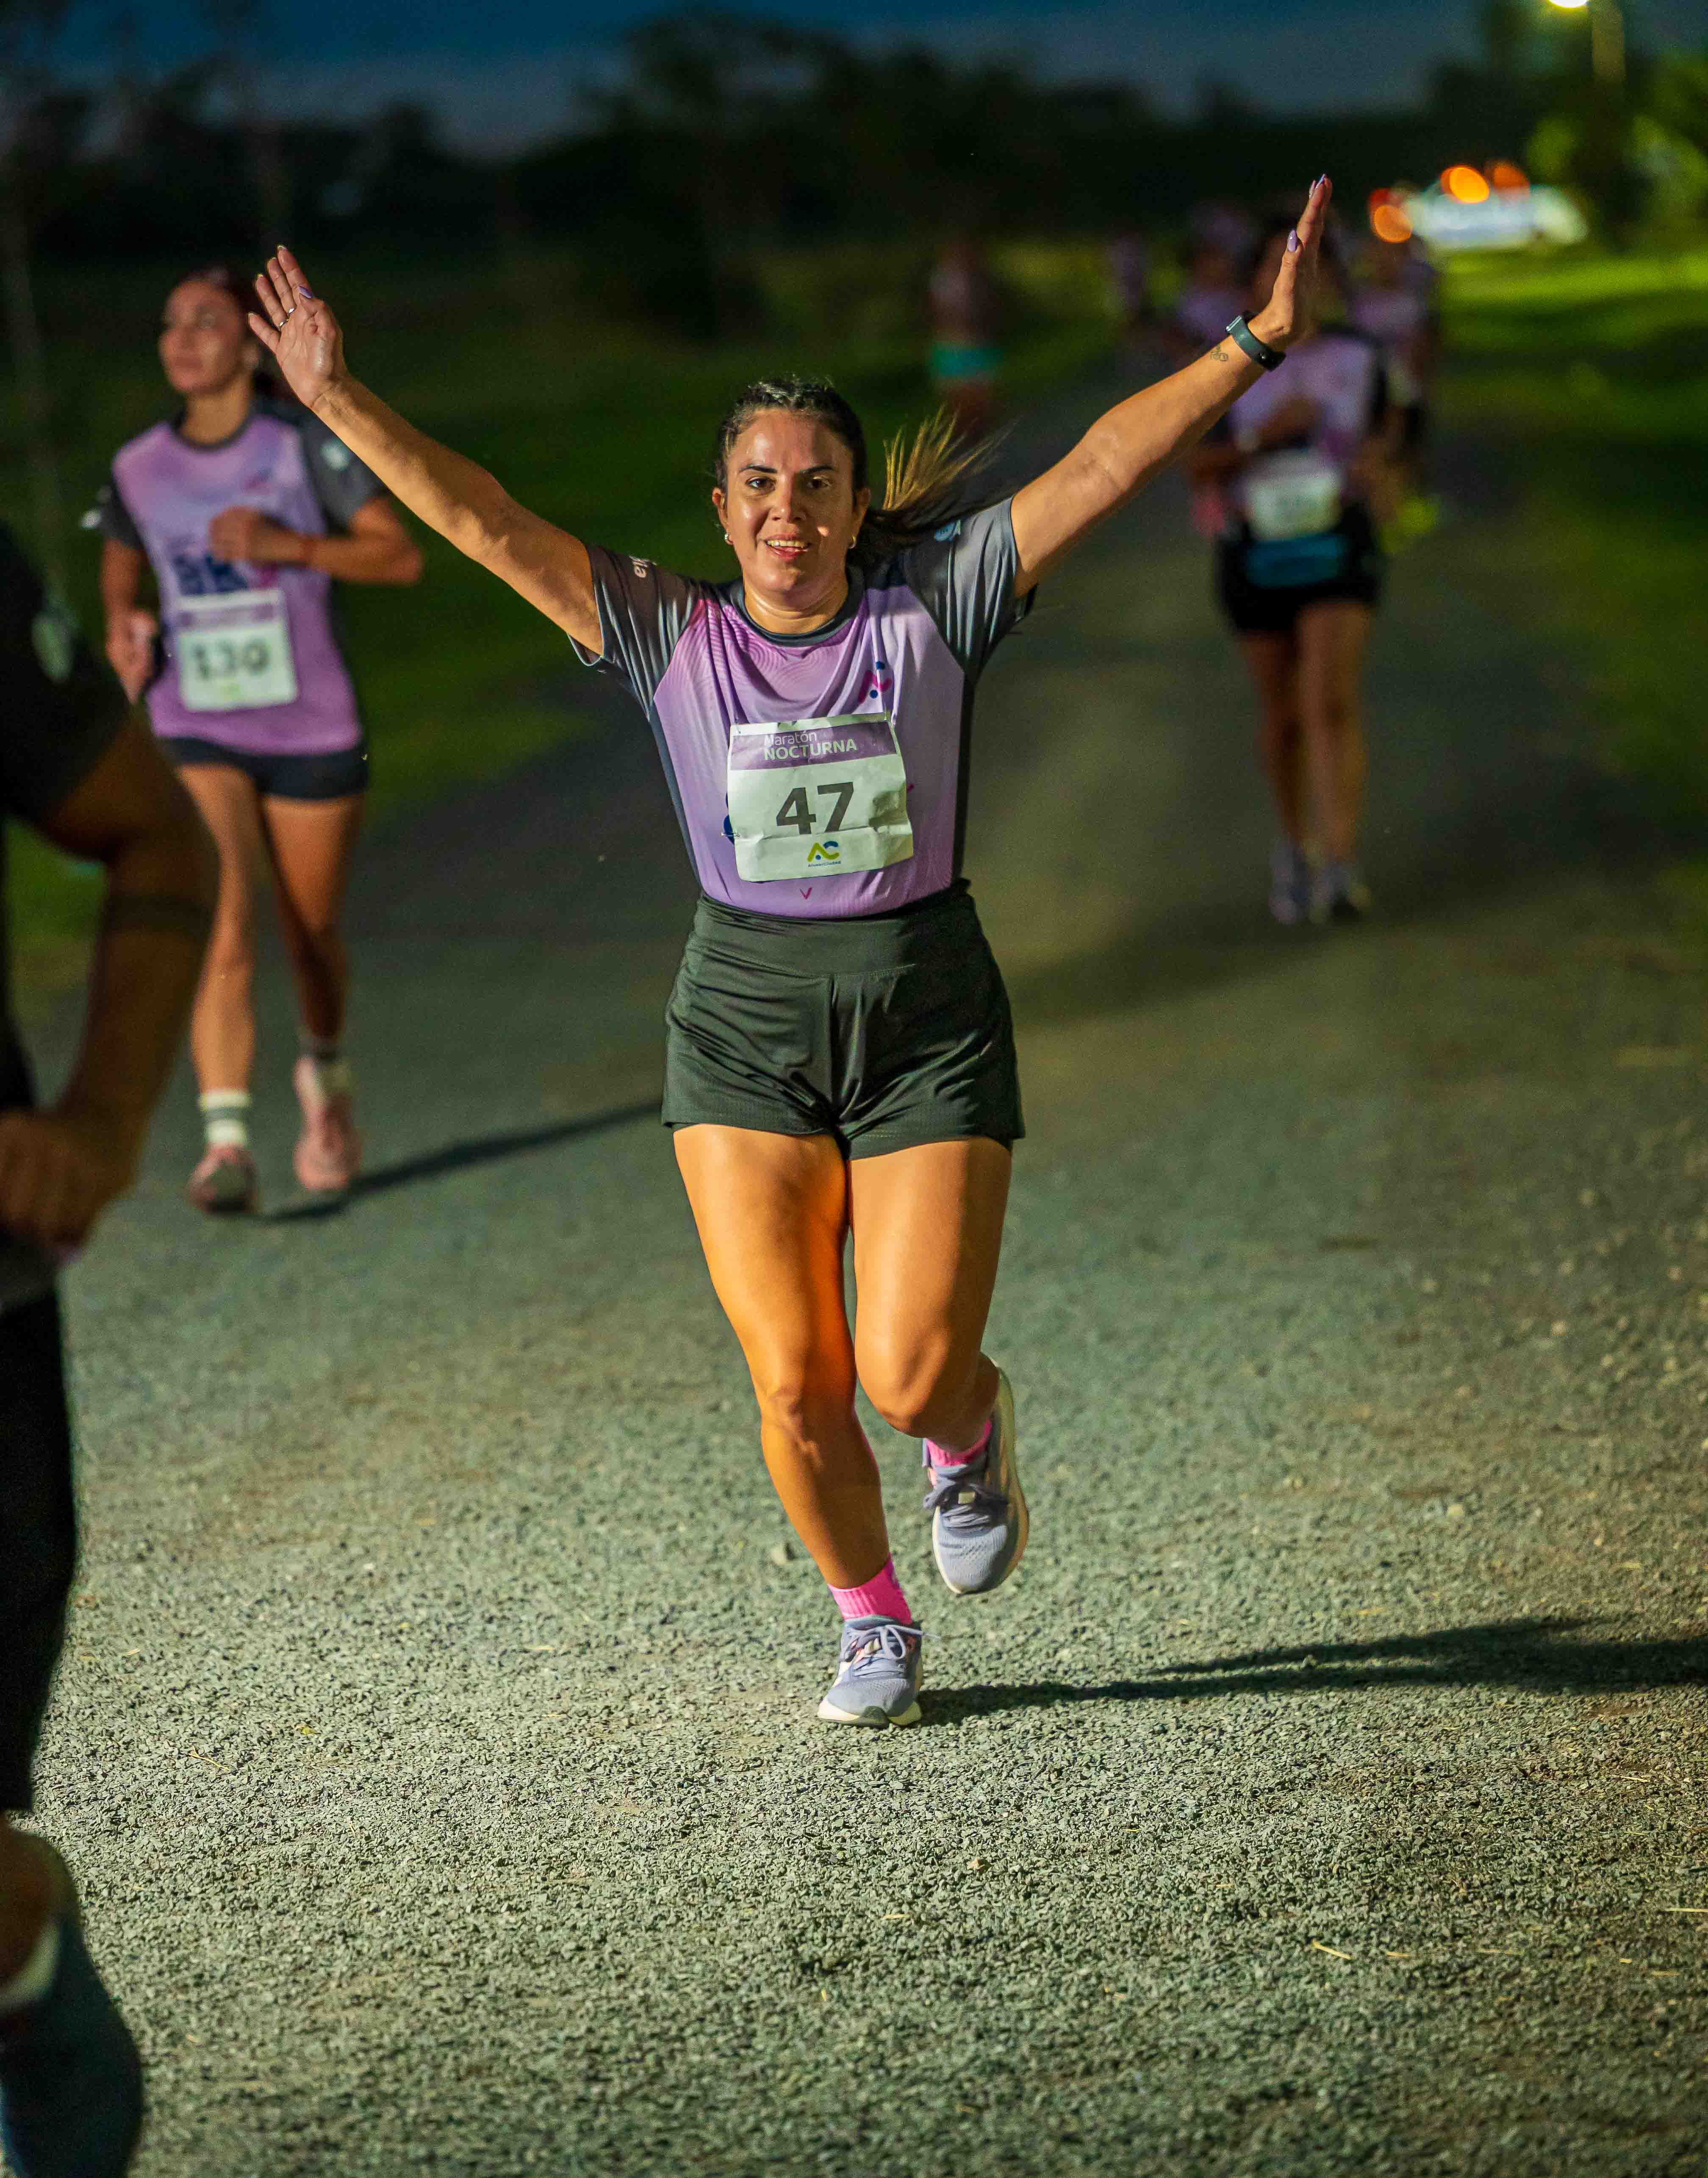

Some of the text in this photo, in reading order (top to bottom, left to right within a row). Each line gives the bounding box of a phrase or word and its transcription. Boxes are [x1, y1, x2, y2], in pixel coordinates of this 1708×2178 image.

[765, 730, 817, 748] Maratón
[765, 738, 857, 760] NOCTURNA
[776, 782, 854, 835] 47
